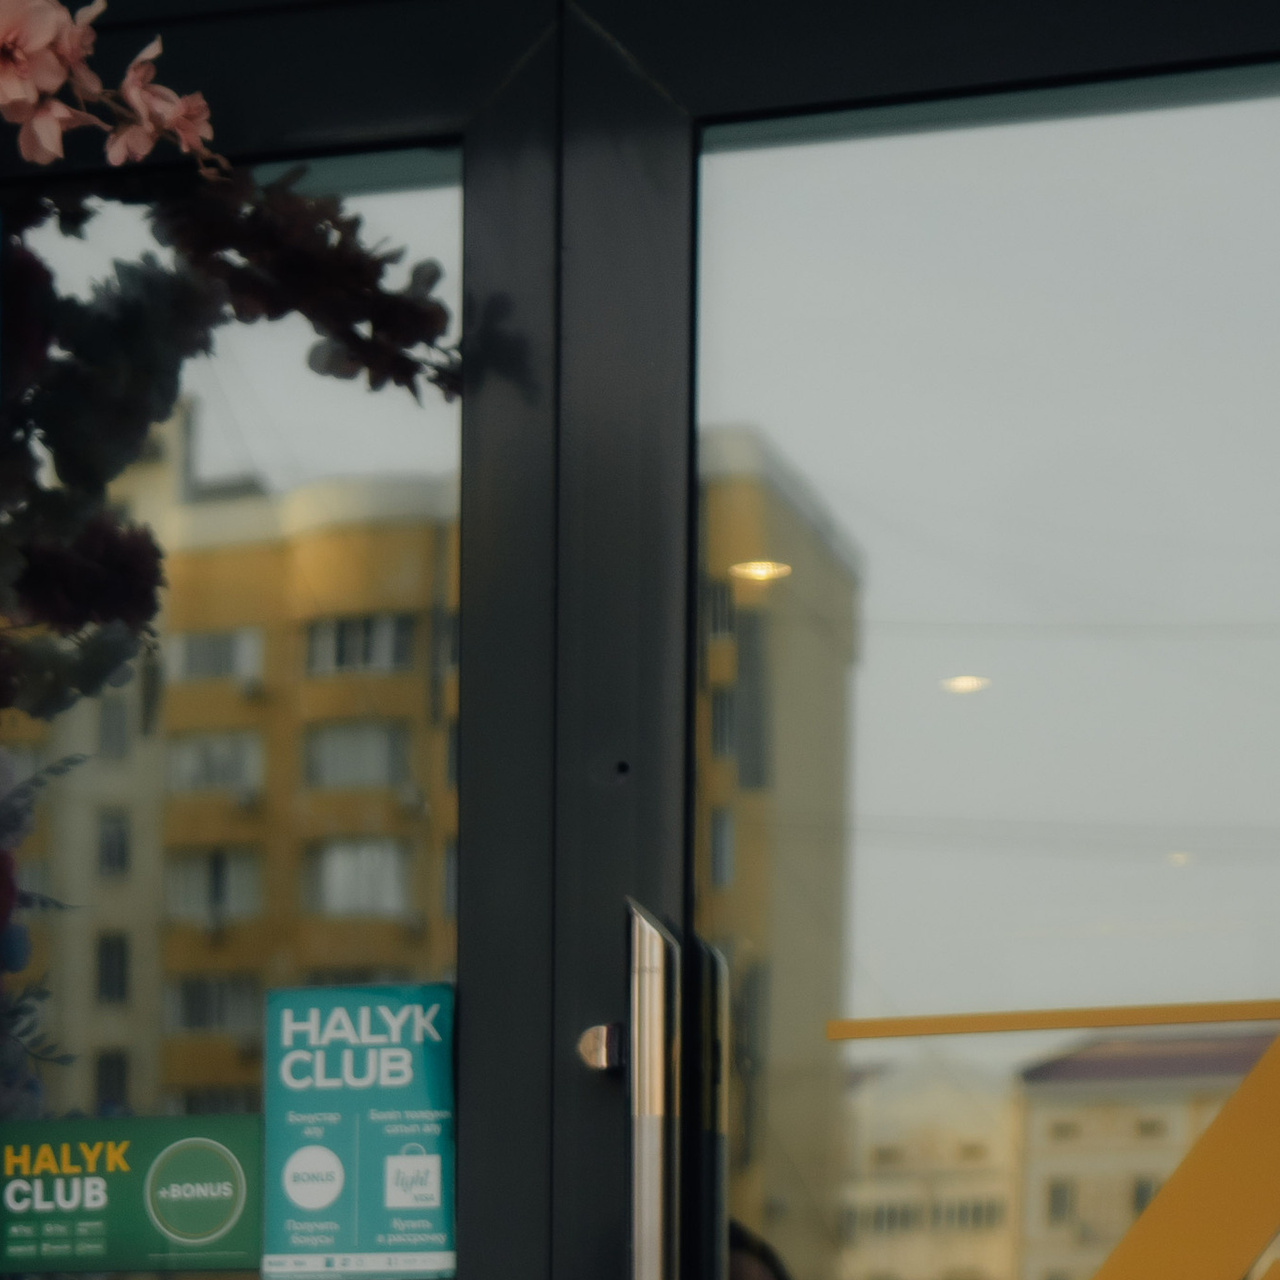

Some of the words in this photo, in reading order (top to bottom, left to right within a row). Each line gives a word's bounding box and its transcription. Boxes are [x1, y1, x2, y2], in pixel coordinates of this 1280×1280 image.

[282, 1003, 442, 1047] HALYK
[280, 1048, 413, 1090] CLUB
[4, 1140, 131, 1175] HALYK
[3, 1176, 108, 1212] CLUB
[292, 1170, 336, 1184] BONUS
